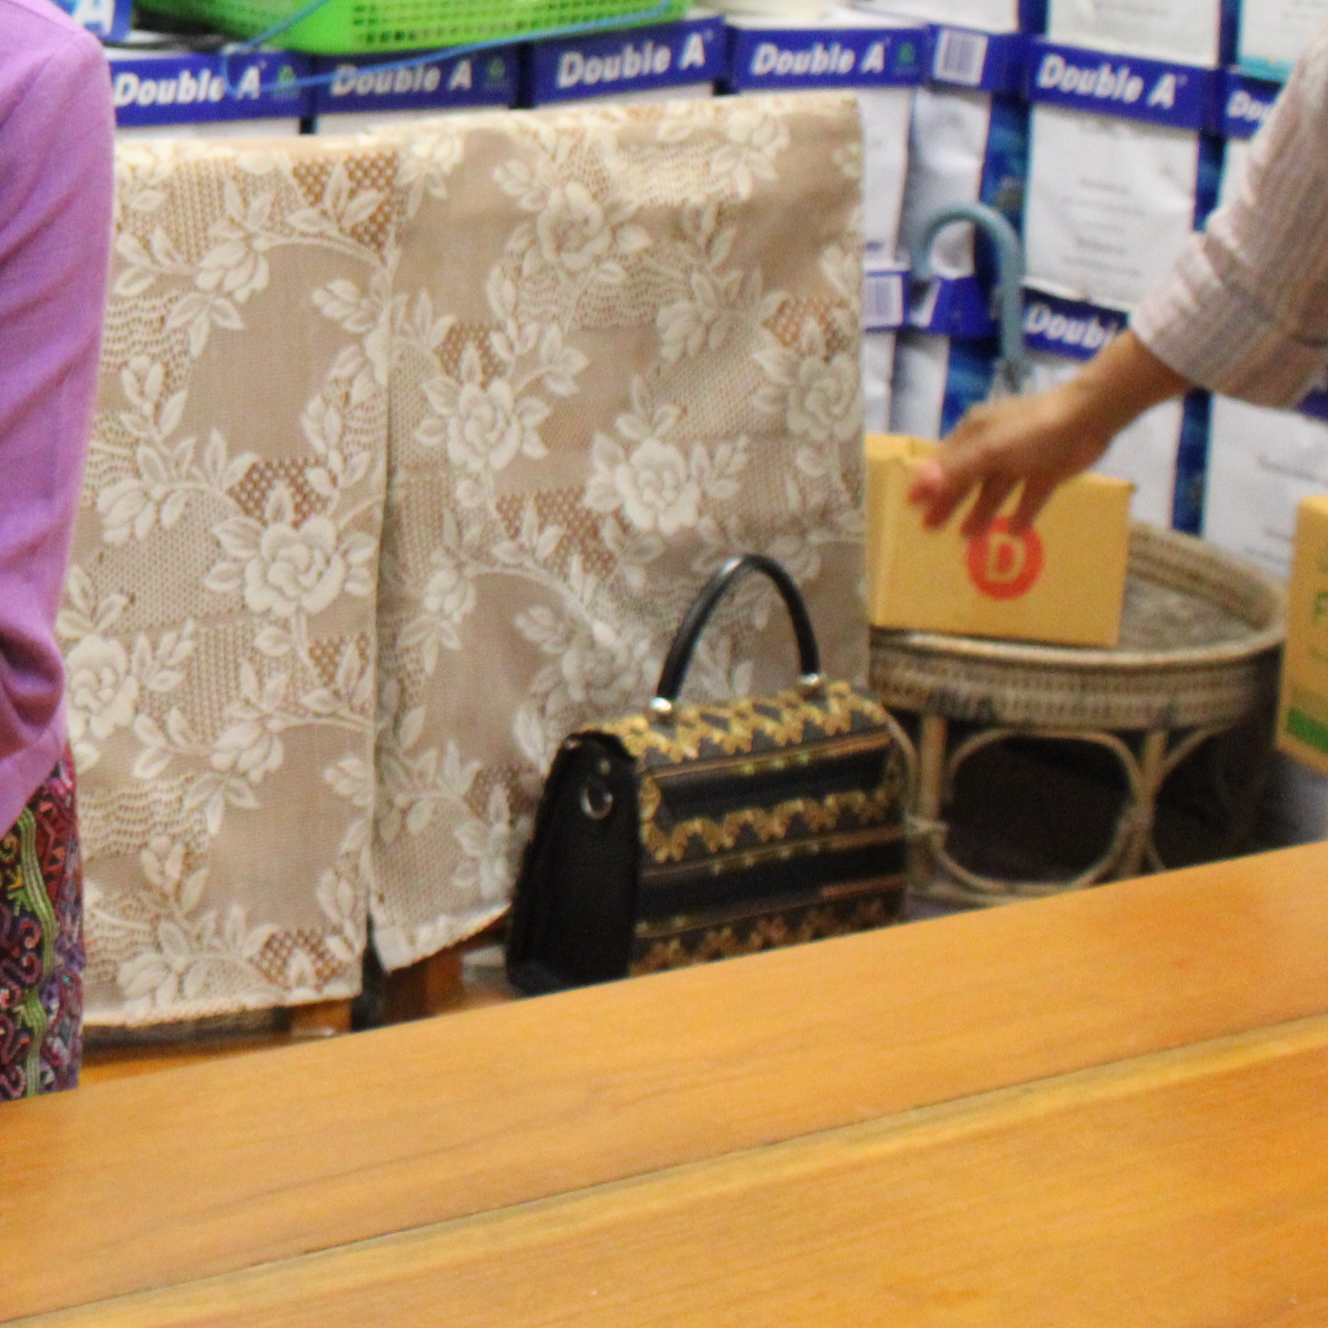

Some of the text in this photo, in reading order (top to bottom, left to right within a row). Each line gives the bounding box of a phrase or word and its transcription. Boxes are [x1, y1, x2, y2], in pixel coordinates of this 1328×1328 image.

[330, 60, 473, 98] Double A
[557, 33, 705, 88] Double A
[750, 41, 885, 76] Double A
[1036, 53, 1176, 109] Double A
[113, 65, 261, 107] Double A
[985, 532, 1025, 583] D
